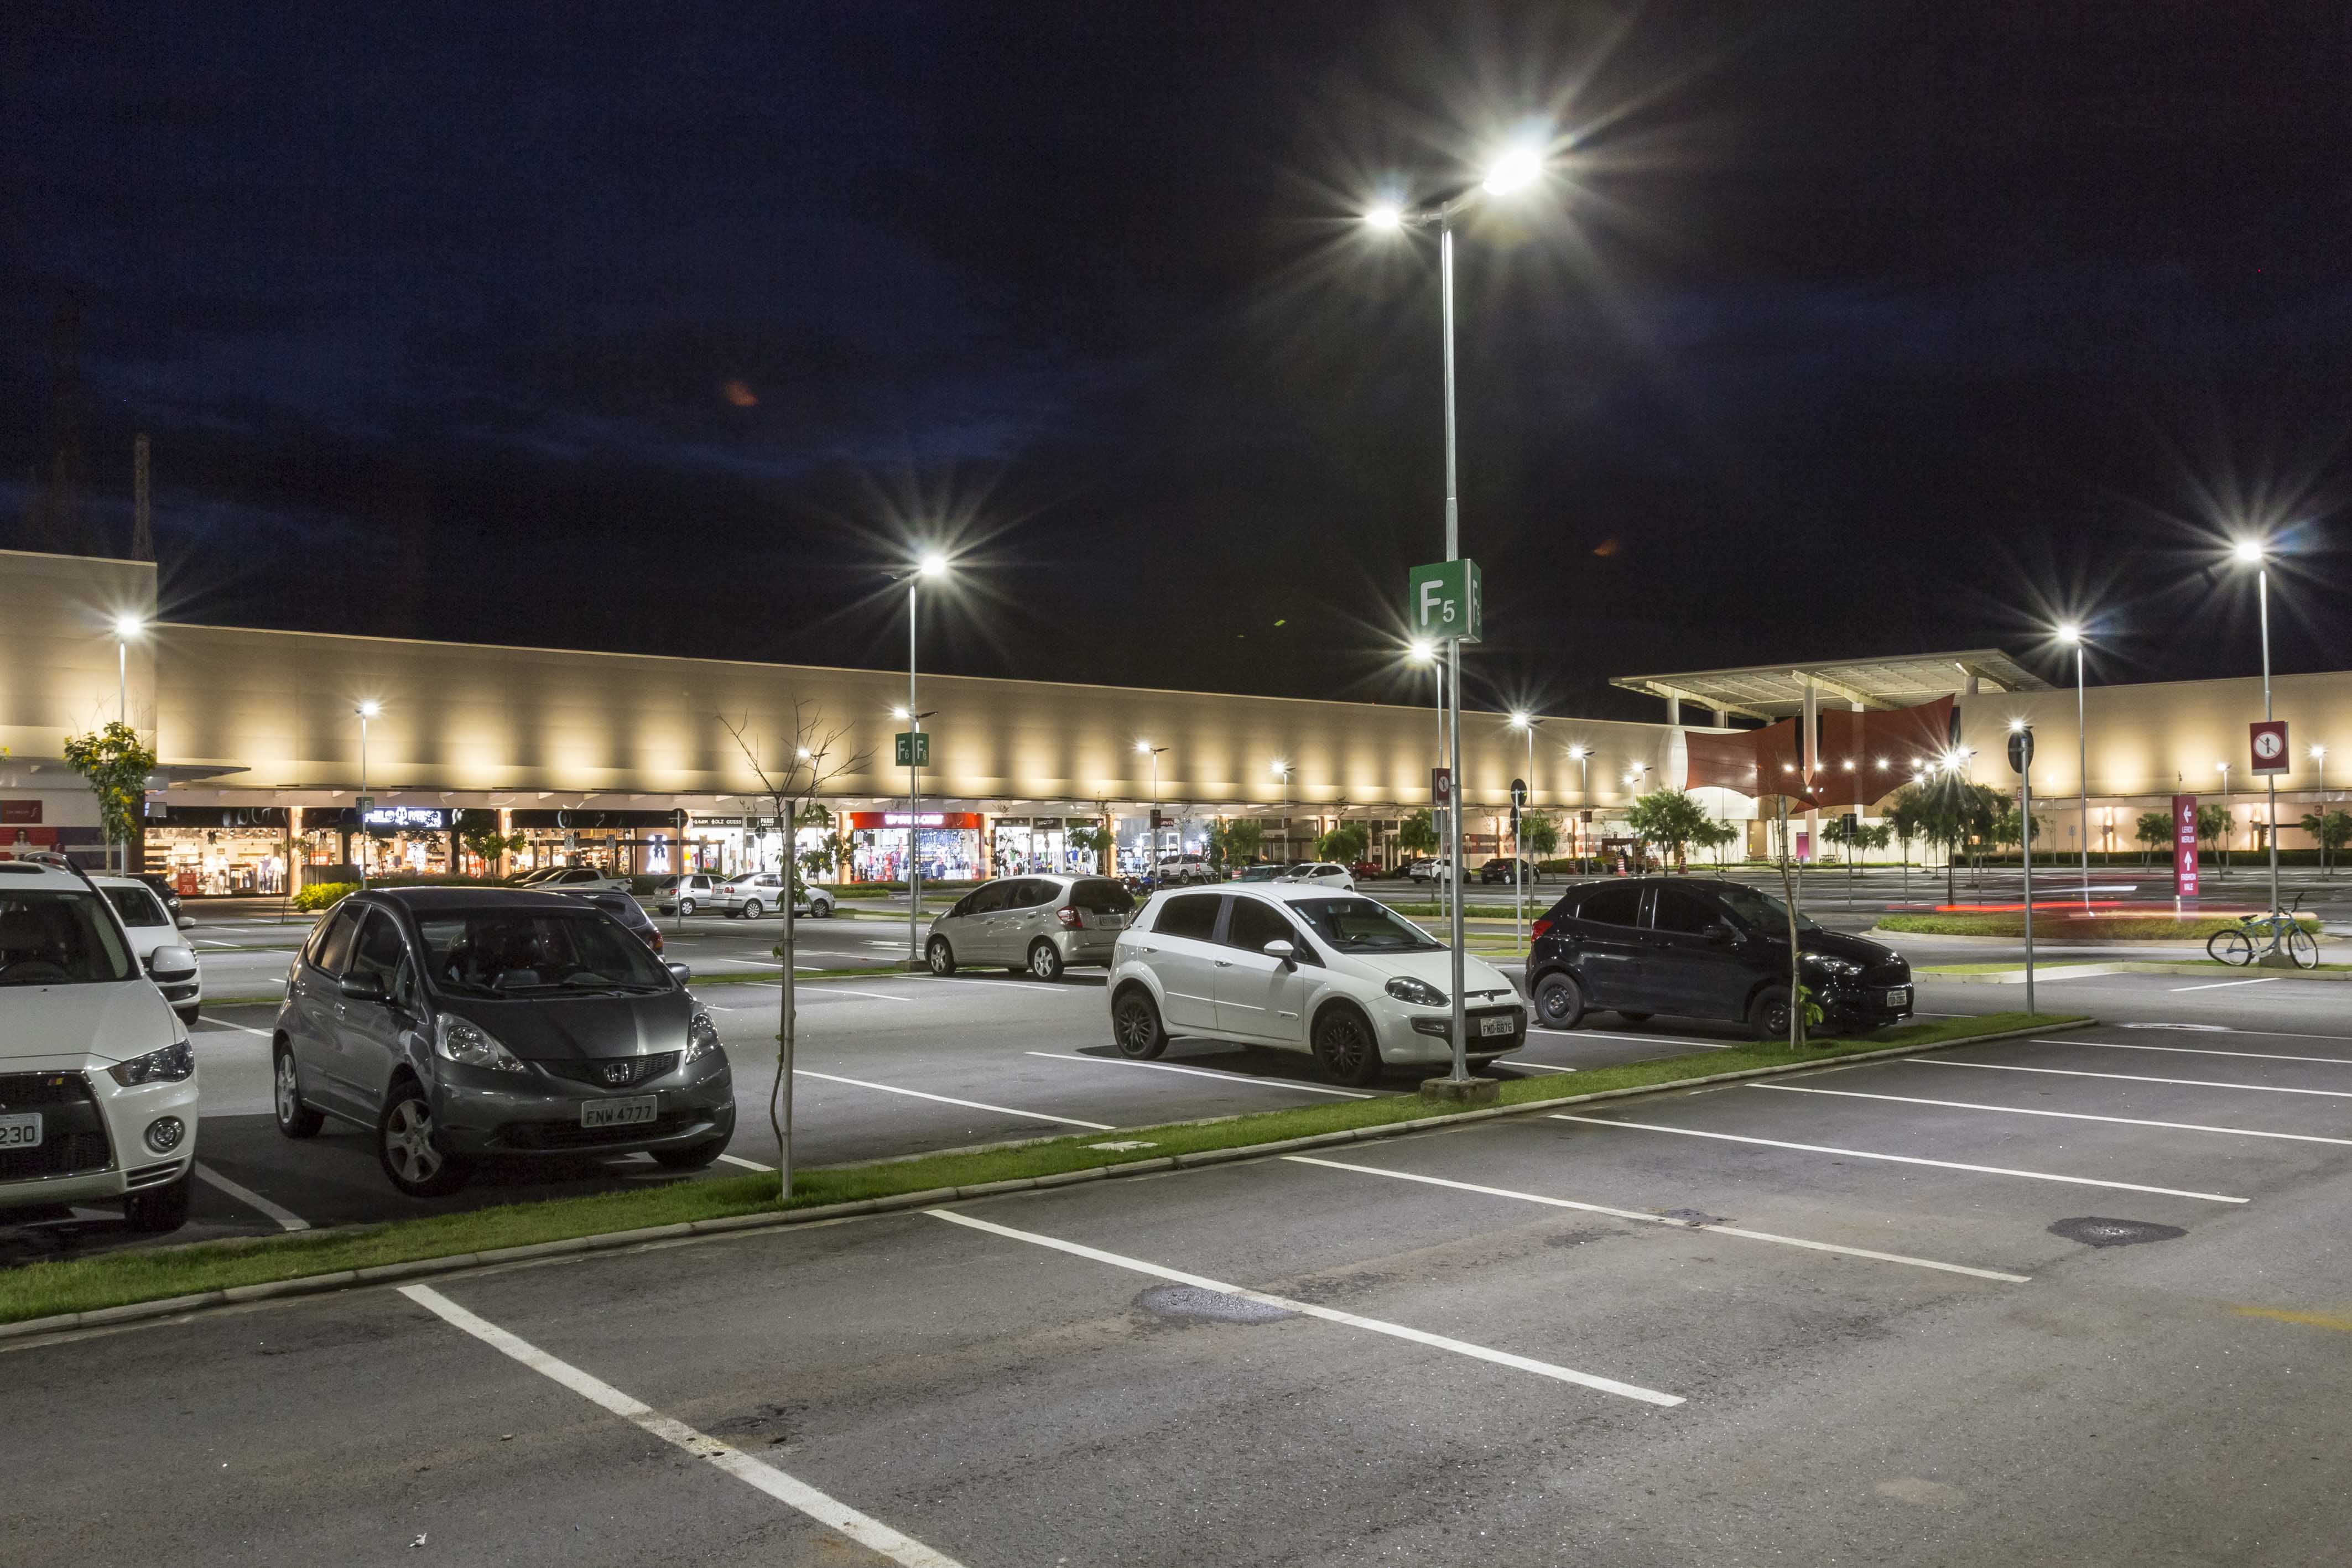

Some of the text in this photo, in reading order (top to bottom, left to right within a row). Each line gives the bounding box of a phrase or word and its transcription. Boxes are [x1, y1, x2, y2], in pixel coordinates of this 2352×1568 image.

[1420, 580, 1455, 627] F5
[898, 740, 909, 760] F6
[183, 884, 193, 893] 70
